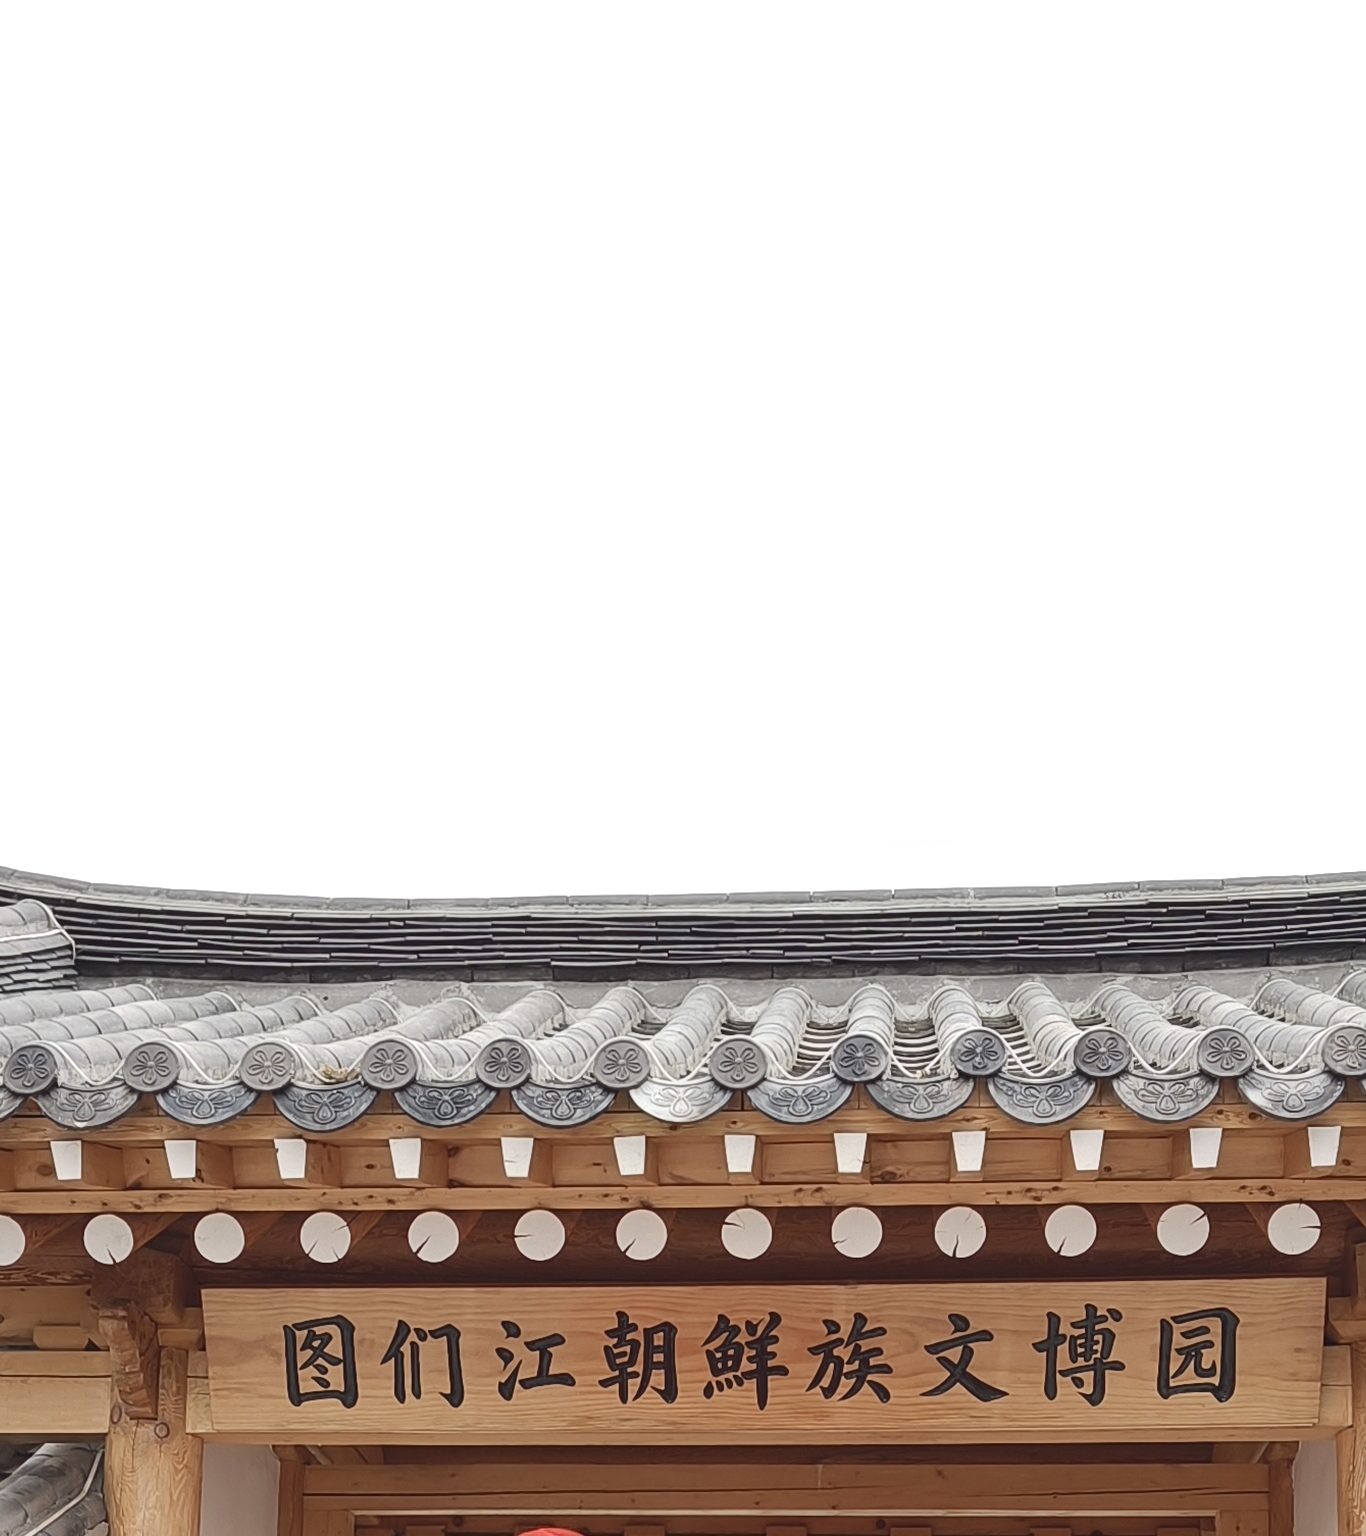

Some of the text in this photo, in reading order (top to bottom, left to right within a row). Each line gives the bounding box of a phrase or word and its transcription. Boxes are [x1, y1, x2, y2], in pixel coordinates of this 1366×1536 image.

[282, 1303, 1240, 1411] 图们江朝鮮族文博园
